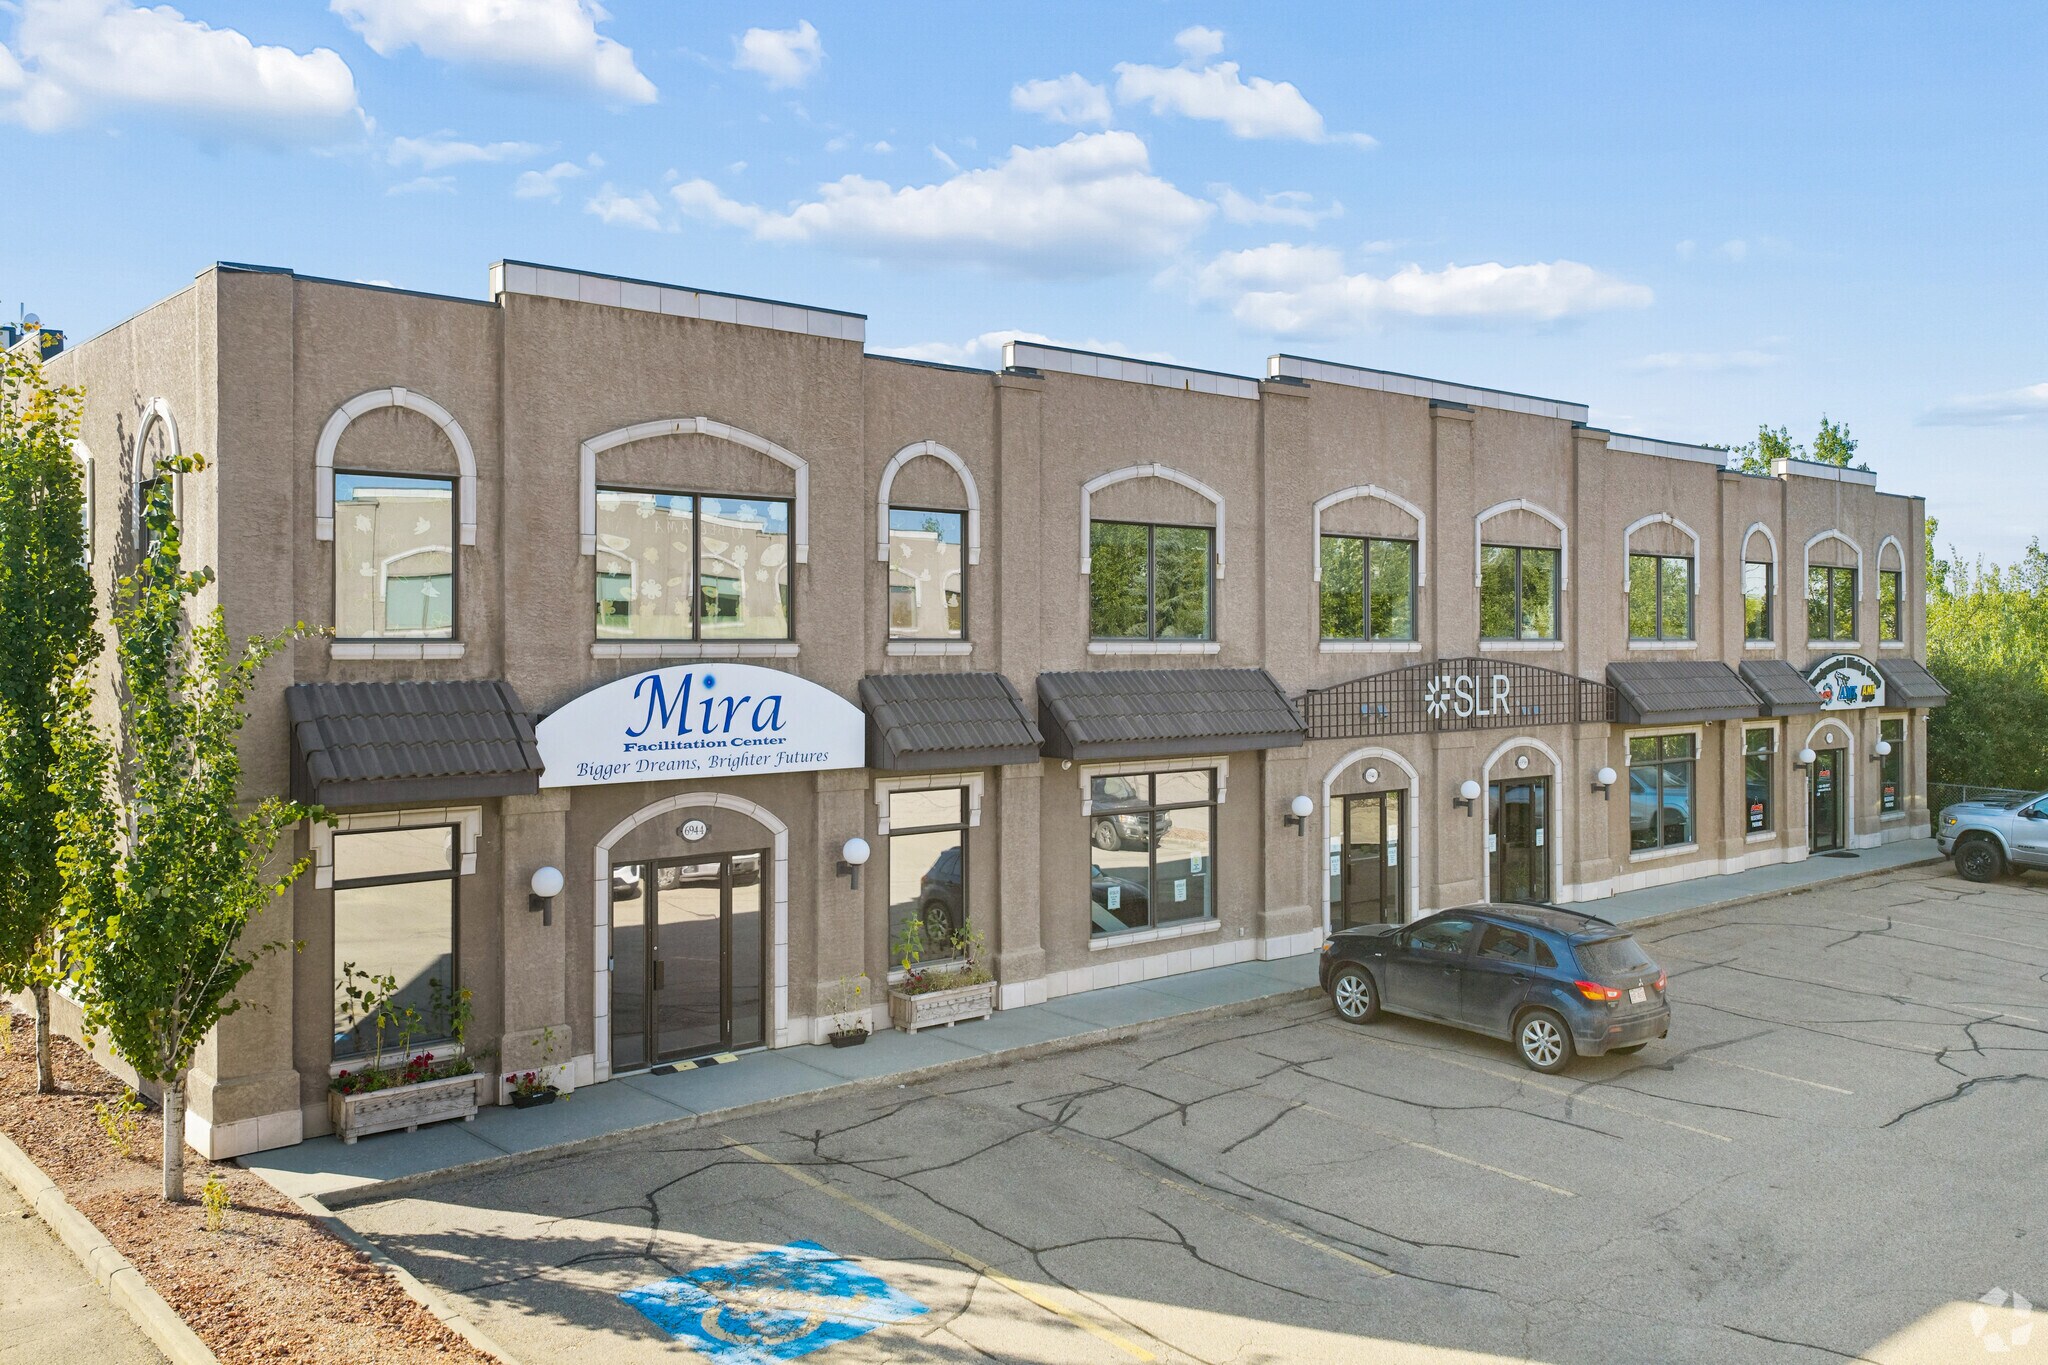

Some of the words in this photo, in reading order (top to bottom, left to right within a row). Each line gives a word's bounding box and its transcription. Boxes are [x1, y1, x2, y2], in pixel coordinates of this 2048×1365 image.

[625, 673, 787, 738] Mira
[1454, 674, 1511, 718] SLR
[623, 739, 728, 752] Facilitation
[730, 736, 787, 747] Center
[576, 761, 631, 781] Bigger
[635, 758, 701, 773] Dreams,
[708, 751, 771, 772] Brighter
[774, 751, 829, 768] Futures
[684, 825, 704, 835] 6944
